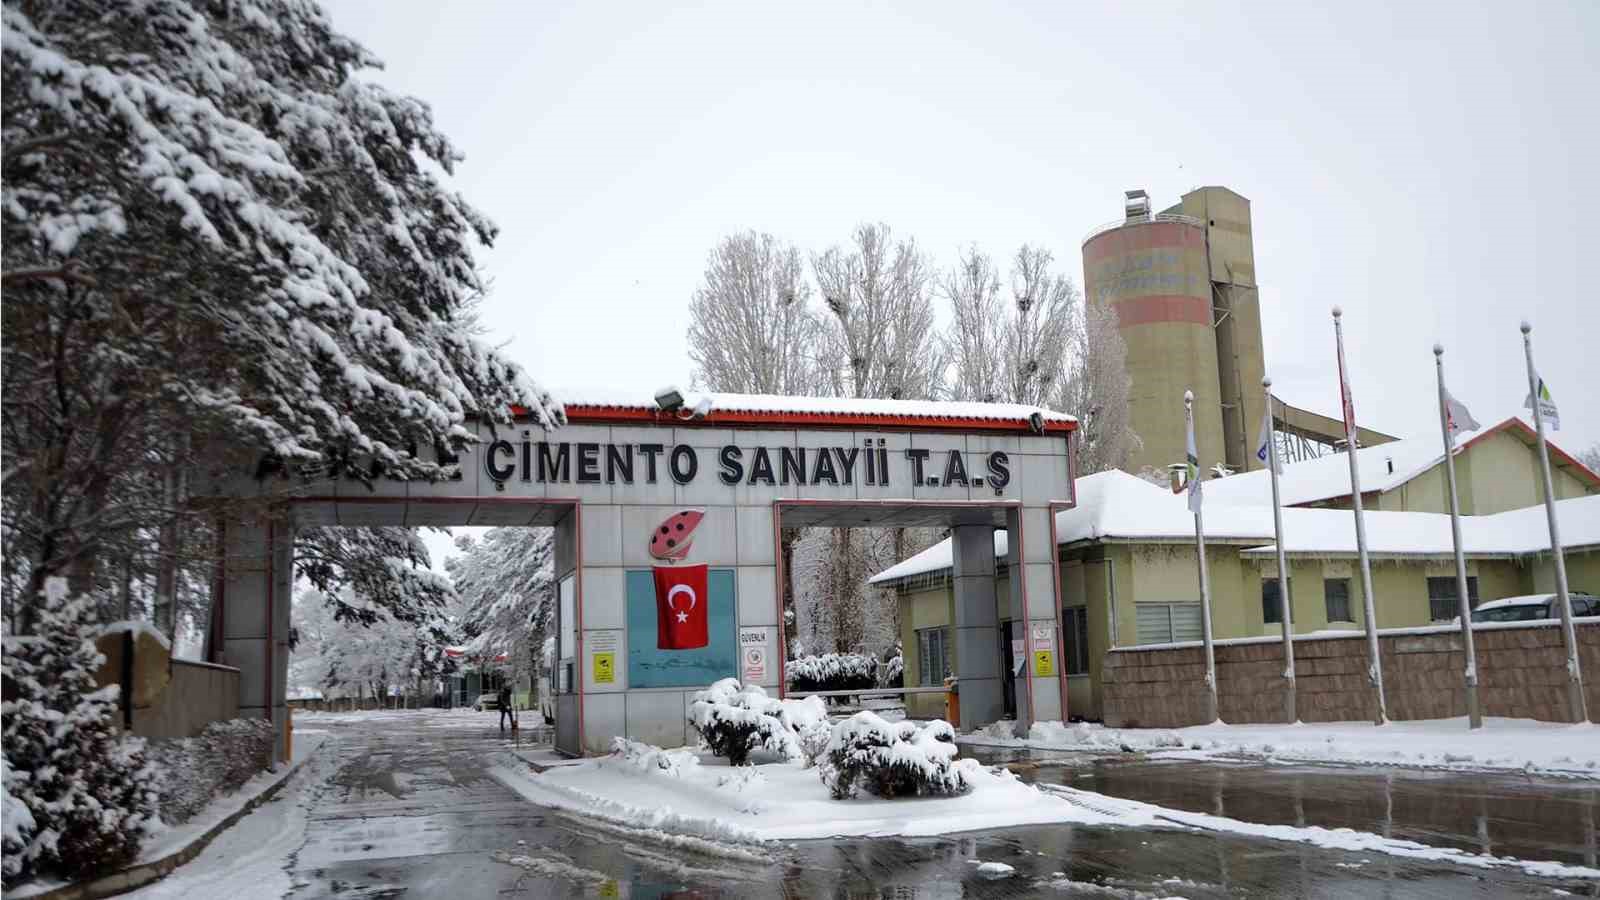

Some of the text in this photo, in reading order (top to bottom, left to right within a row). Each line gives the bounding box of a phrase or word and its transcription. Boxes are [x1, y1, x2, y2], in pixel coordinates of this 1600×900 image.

[484, 430, 699, 491] ÇİMENTO
[719, 438, 890, 487] SANAYİİ
[905, 448, 1011, 497] T.A.Ş
